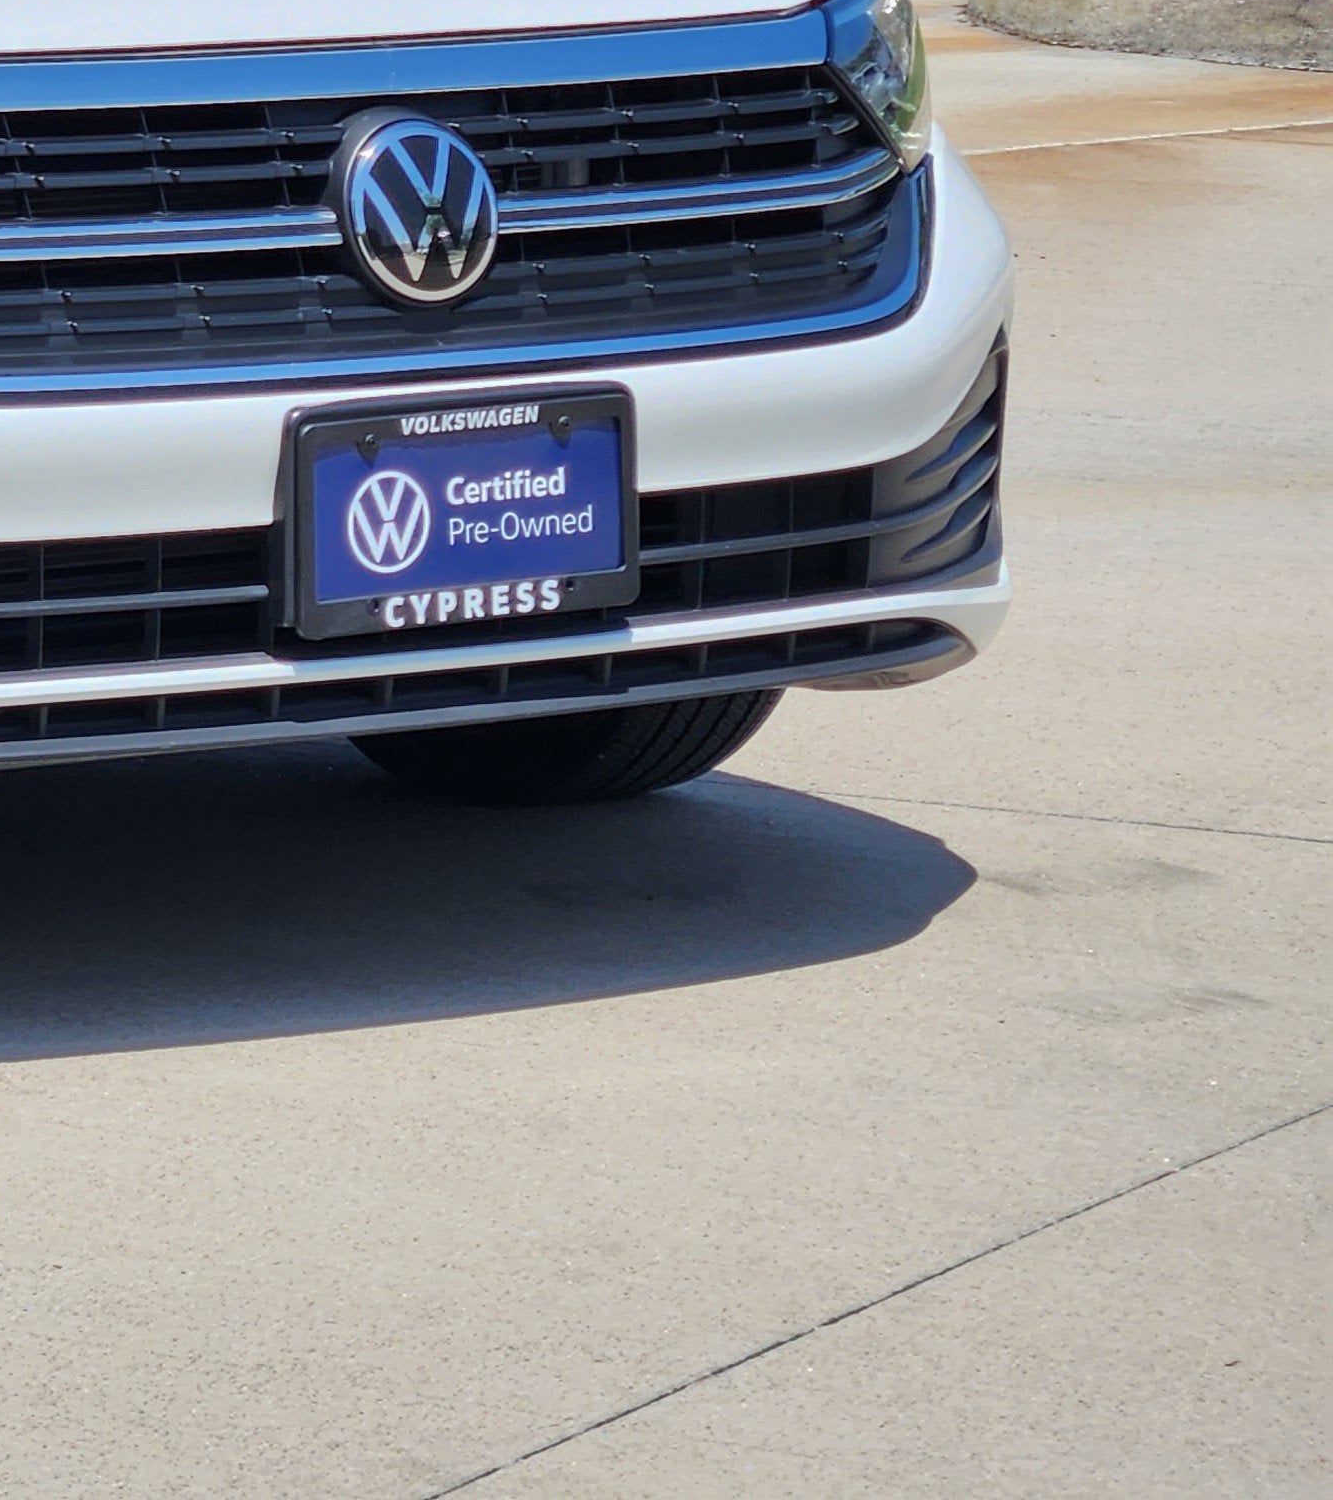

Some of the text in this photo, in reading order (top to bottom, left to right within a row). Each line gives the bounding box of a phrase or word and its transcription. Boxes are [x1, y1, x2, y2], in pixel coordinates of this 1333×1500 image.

[401, 405, 540, 436] VOLKSWAGEN
[447, 466, 566, 505] Certified
[349, 471, 430, 573] VW
[449, 504, 593, 546] Pre-Owned
[385, 579, 561, 628] CYPRESS
